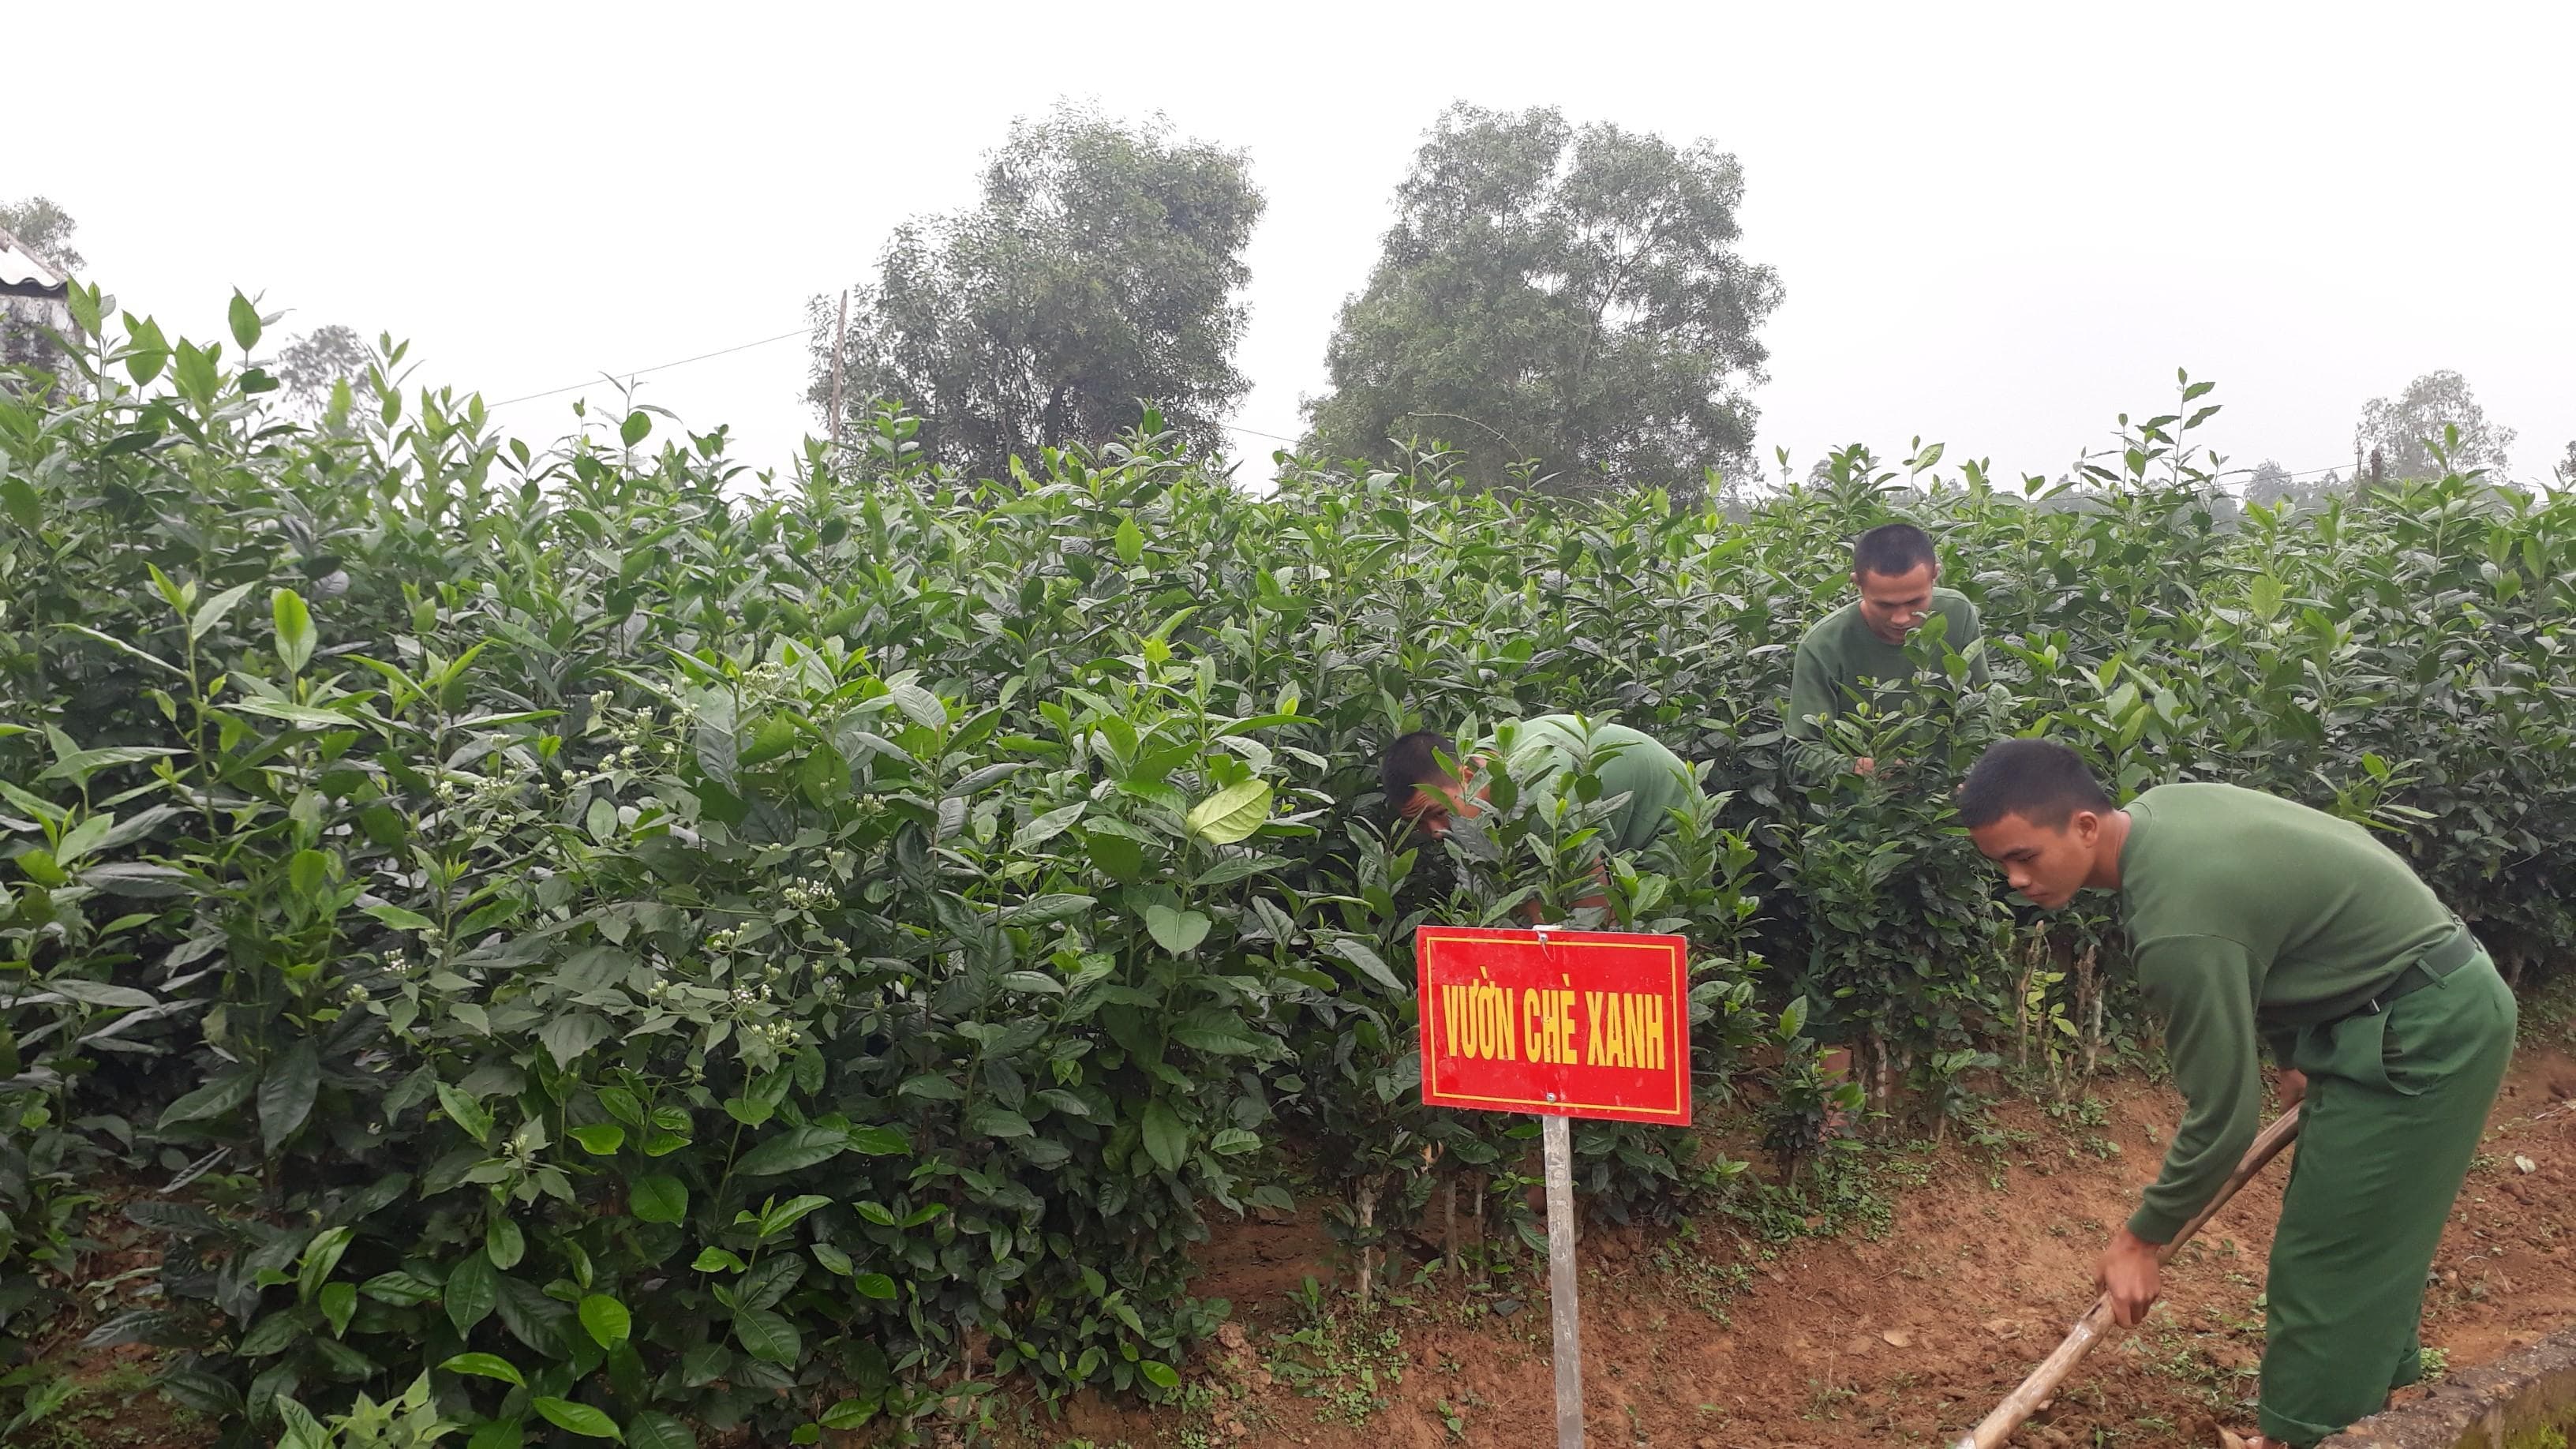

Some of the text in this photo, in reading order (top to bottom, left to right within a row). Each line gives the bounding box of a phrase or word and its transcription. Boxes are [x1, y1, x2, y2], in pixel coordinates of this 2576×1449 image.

[1442, 966, 1665, 1070] VƯỜN CHÈ XANH
